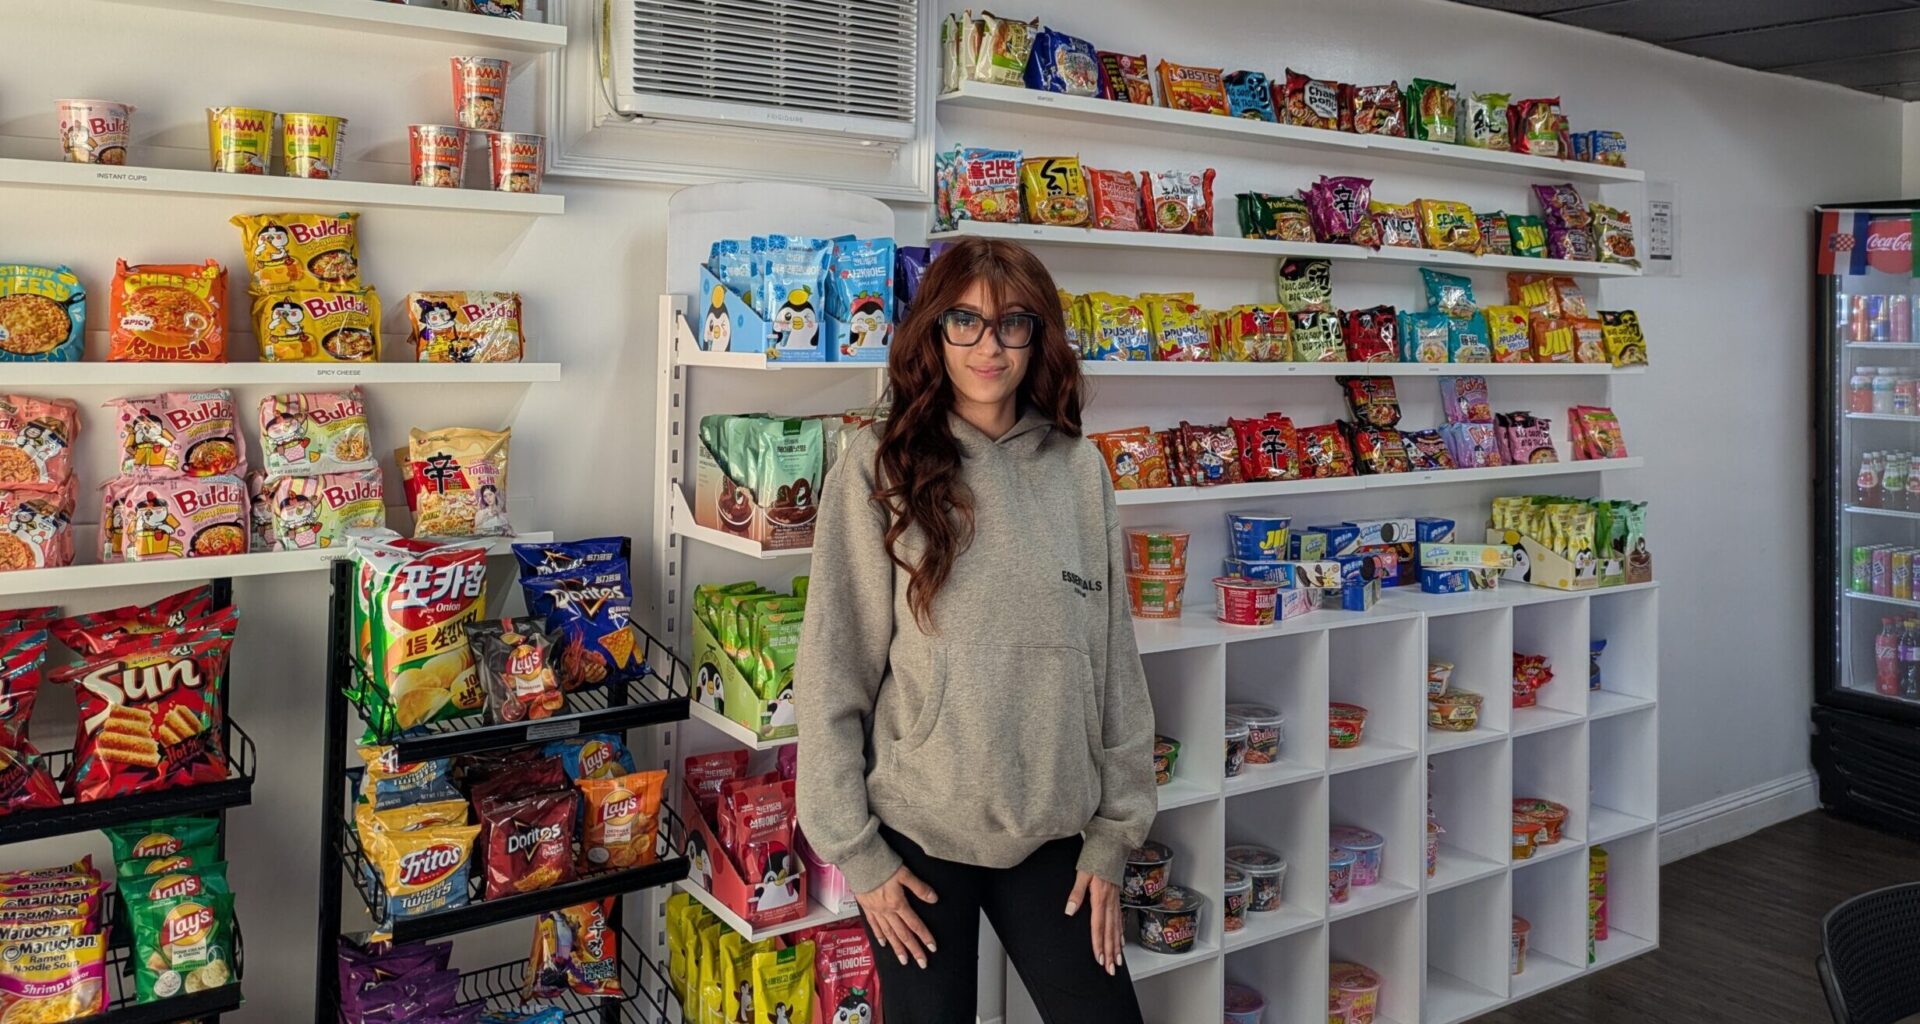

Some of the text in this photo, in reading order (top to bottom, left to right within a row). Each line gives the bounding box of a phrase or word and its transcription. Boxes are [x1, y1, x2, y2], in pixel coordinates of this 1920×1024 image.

[89, 117, 129, 136] Buld
[97, 173, 148, 182] INSTANT CUPS
[968, 179, 988, 187] HULA
[1332, 184, 1356, 230] 辛
[1866, 232, 1913, 252] Coca-Co
[0, 275, 71, 302] HEESY
[124, 273, 212, 300] CHEESY
[304, 295, 369, 320] Buldak
[122, 317, 151, 328] SPICY
[1, 349, 68, 362] AMEN
[127, 336, 211, 361] RAMEN
[317, 369, 361, 377] SPICY CHEESE
[307, 402, 366, 426] Bulda
[1261, 426, 1288, 470] 辛
[423, 452, 462, 495] 辛
[174, 485, 244, 517] Buldak
[324, 482, 384, 511] Buldak
[391, 563, 486, 610] 포카칩
[436, 601, 461, 612] Onion
[510, 651, 541, 676] Lay's
[82, 659, 202, 735] Sun
[582, 743, 611, 775] Lay's
[603, 796, 637, 820] Lay's
[508, 823, 562, 854] Doritos
[400, 846, 462, 883] Fritos
[401, 882, 452, 909] TWISTS
[169, 907, 214, 943] Lay's
[19, 936, 96, 955] Maruchan
[29, 953, 67, 963] Ramen
[13, 959, 81, 973] Noodle Soup
[22, 982, 65, 995] Shrimp
